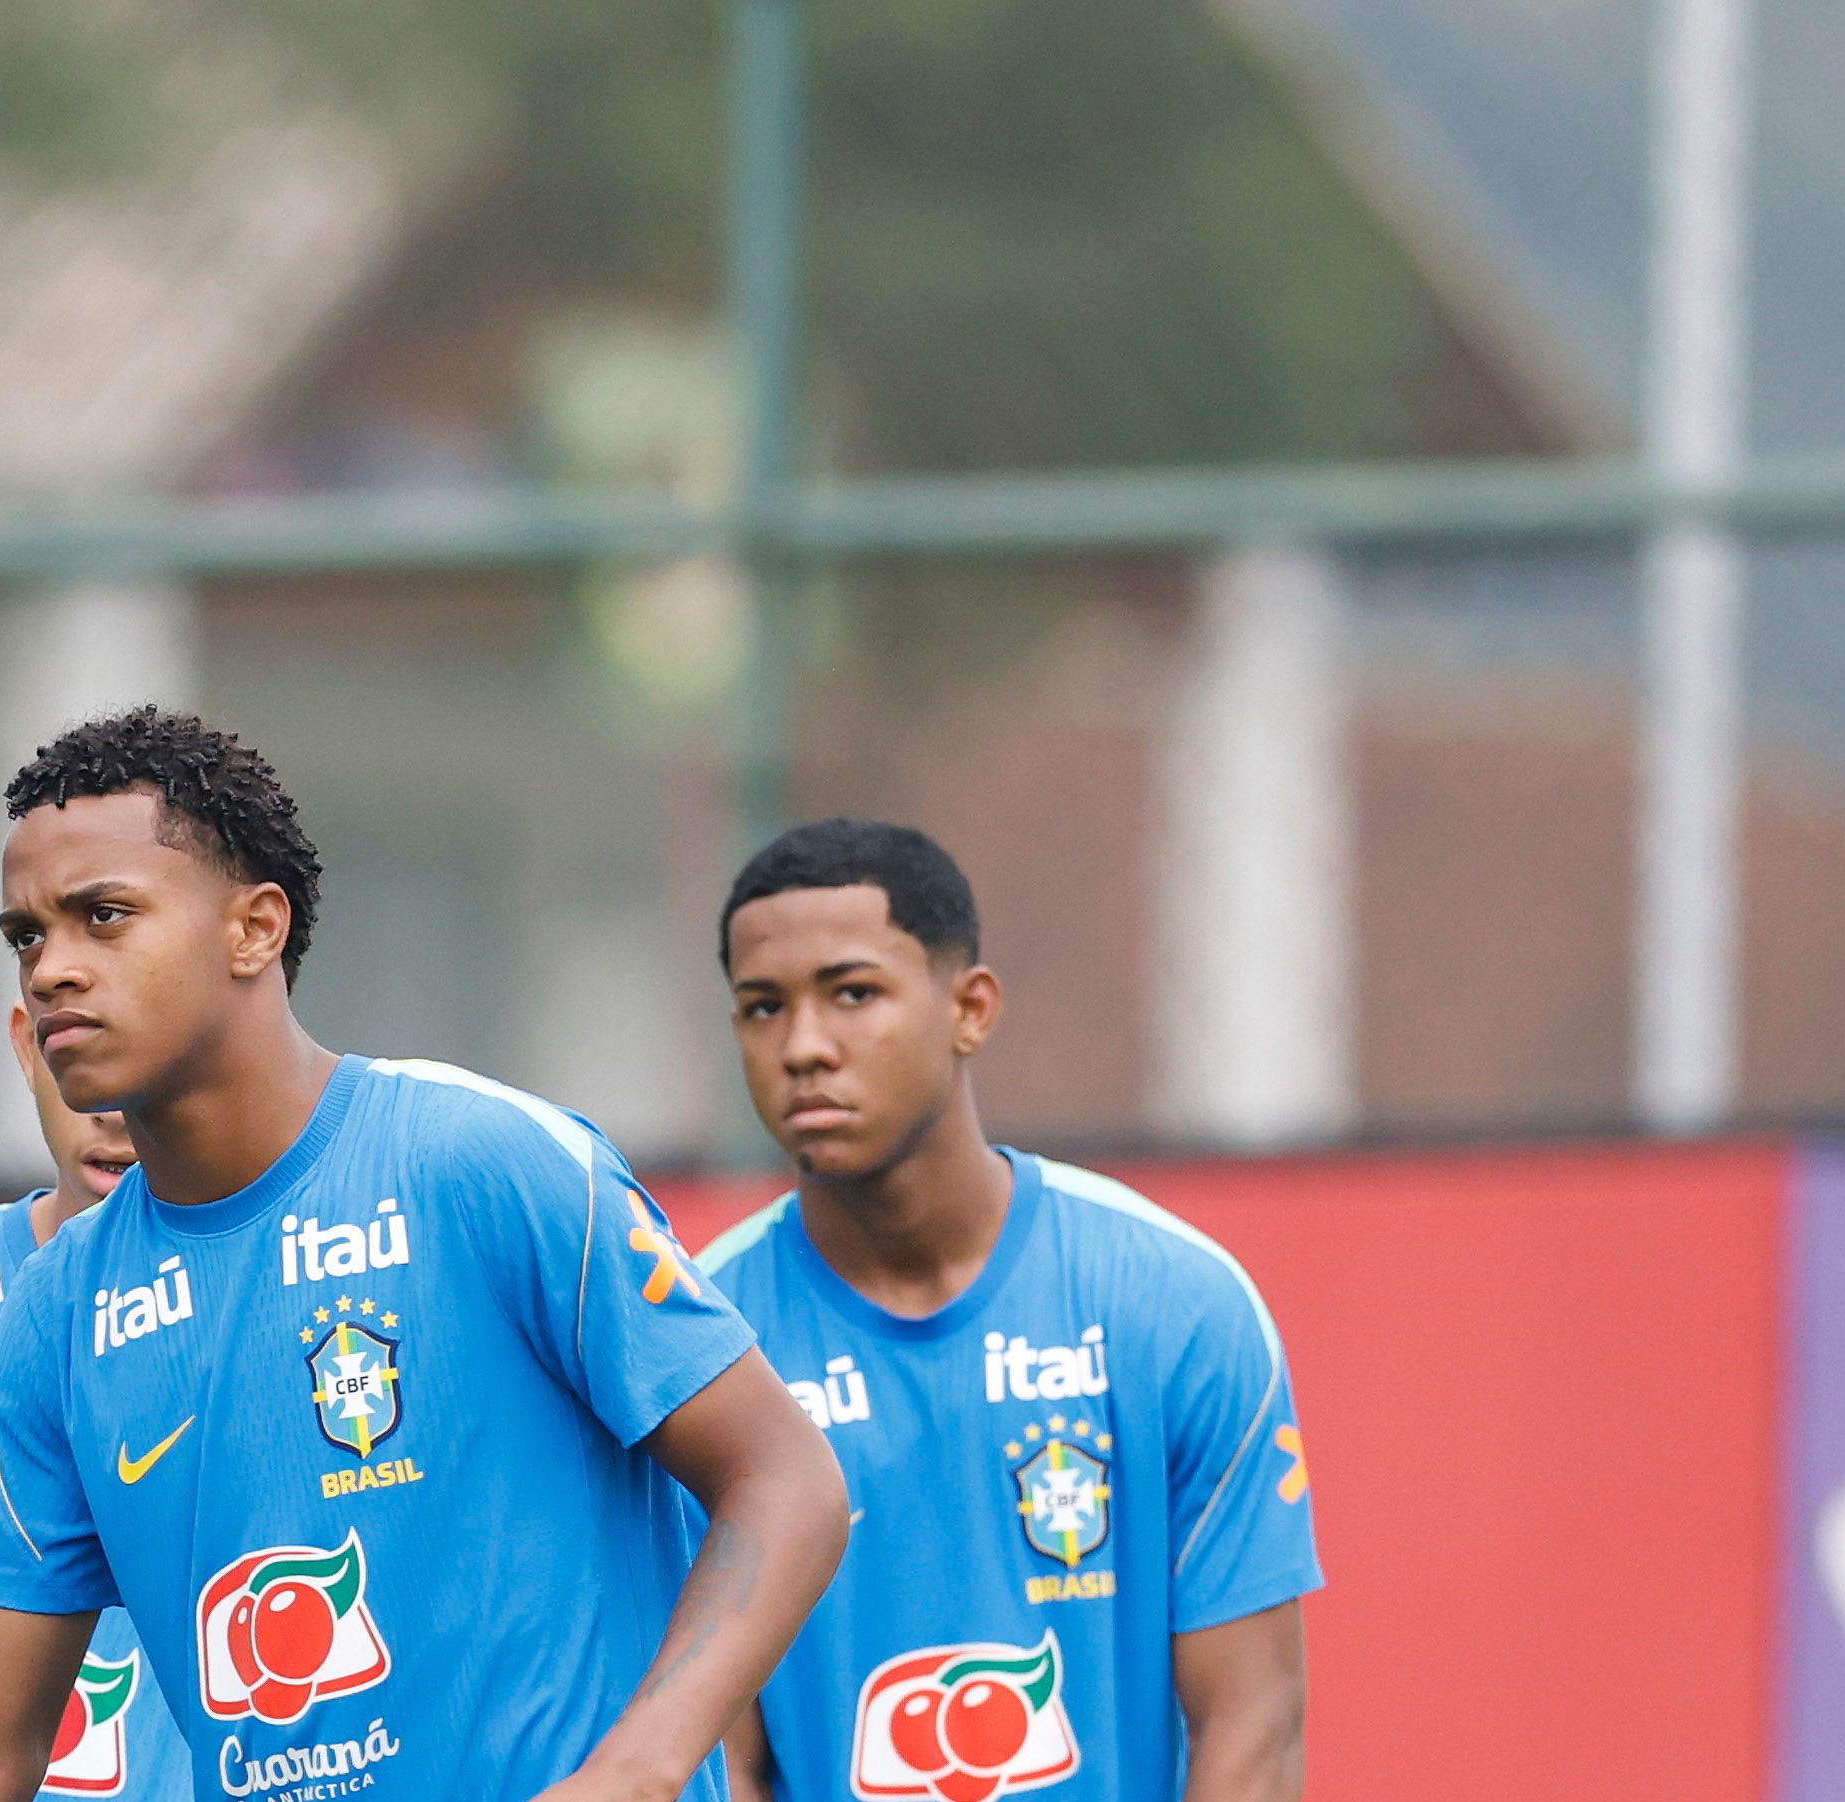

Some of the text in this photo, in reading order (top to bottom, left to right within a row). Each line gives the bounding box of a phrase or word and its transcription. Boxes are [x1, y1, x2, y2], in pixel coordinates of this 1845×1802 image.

[280, 1197, 411, 1286] itaú
[93, 1255, 194, 1358] itaú
[335, 1375, 370, 1395] CBF
[983, 1324, 1110, 1403] itaú
[320, 1457, 425, 1499] BRASIL
